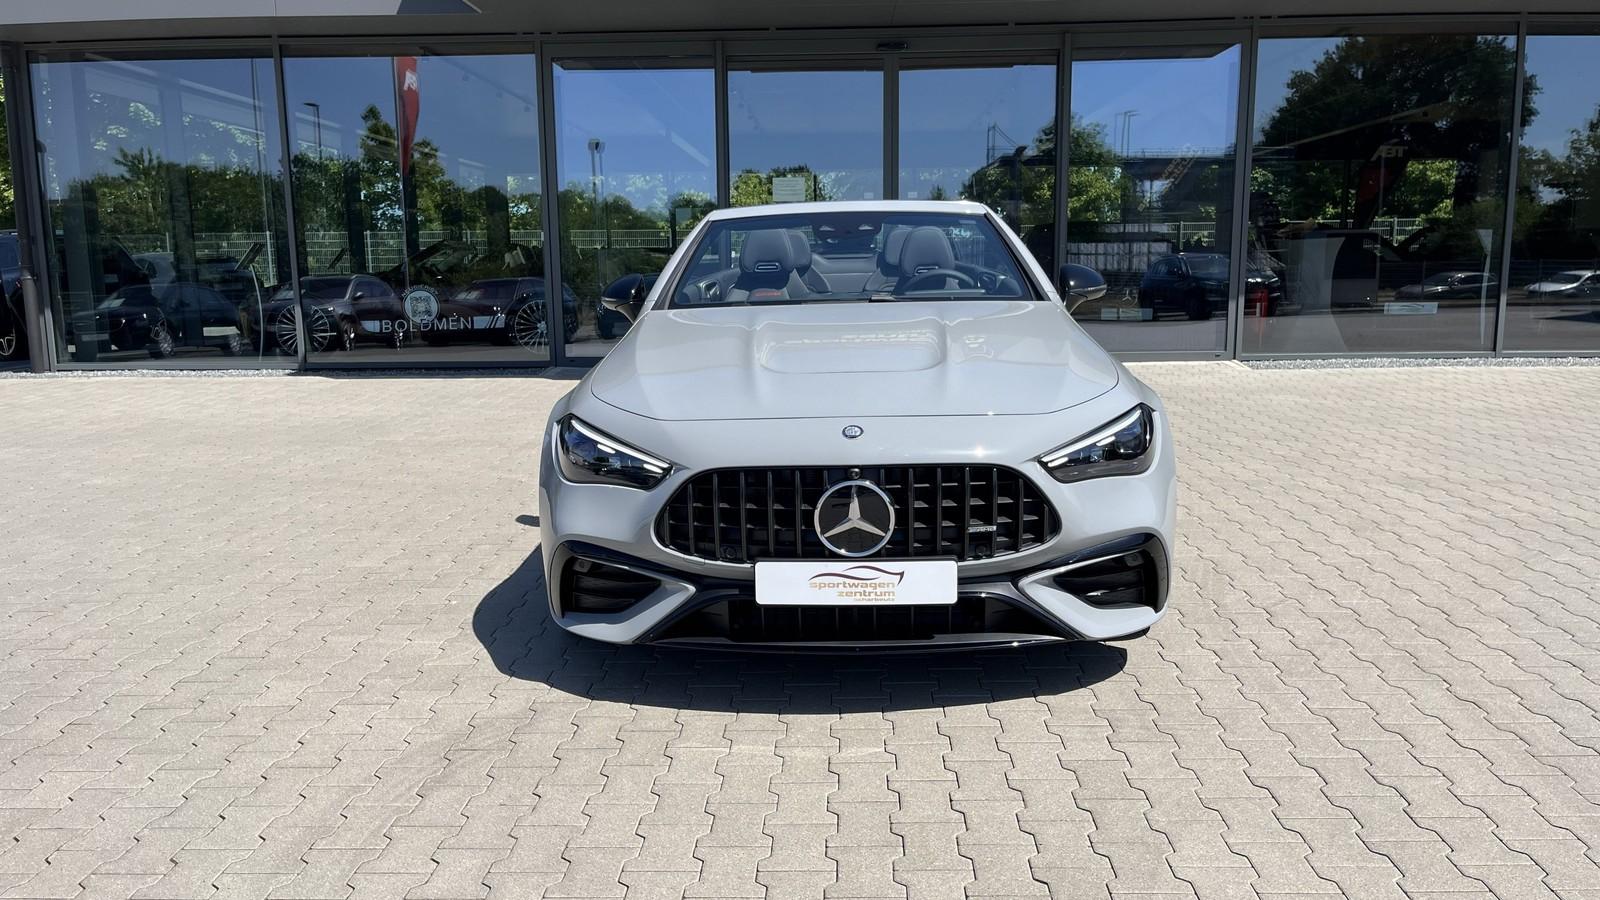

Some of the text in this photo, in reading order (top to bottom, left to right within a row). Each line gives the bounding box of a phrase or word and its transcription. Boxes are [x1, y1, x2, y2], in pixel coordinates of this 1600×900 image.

[1370, 143, 1408, 161] ABT
[382, 317, 472, 333] BOLDMEN
[809, 581, 896, 591] sportwagen
[837, 589, 896, 597] zentrum
